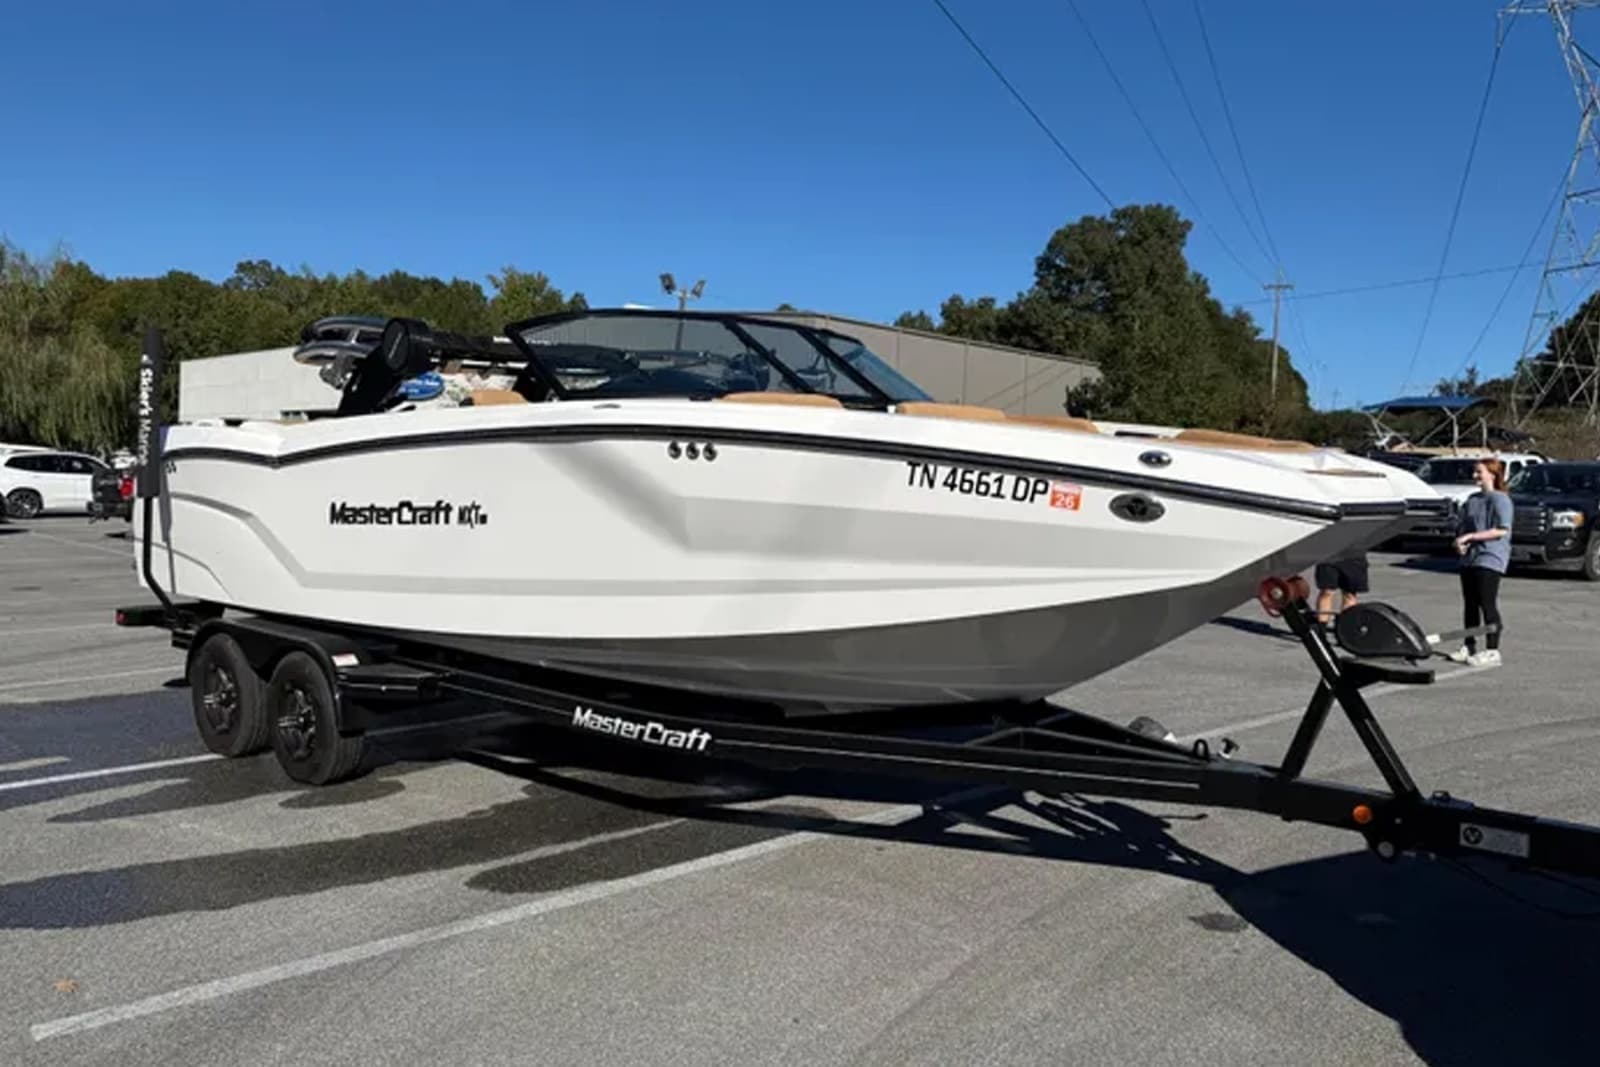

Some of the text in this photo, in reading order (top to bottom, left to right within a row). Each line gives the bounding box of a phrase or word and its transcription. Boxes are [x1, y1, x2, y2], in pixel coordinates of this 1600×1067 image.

[906, 461, 1050, 503] TN 4661 DP
[329, 500, 453, 525] MasterCraft
[1055, 493, 1075, 509] 26
[571, 705, 712, 751] MasterCraft
